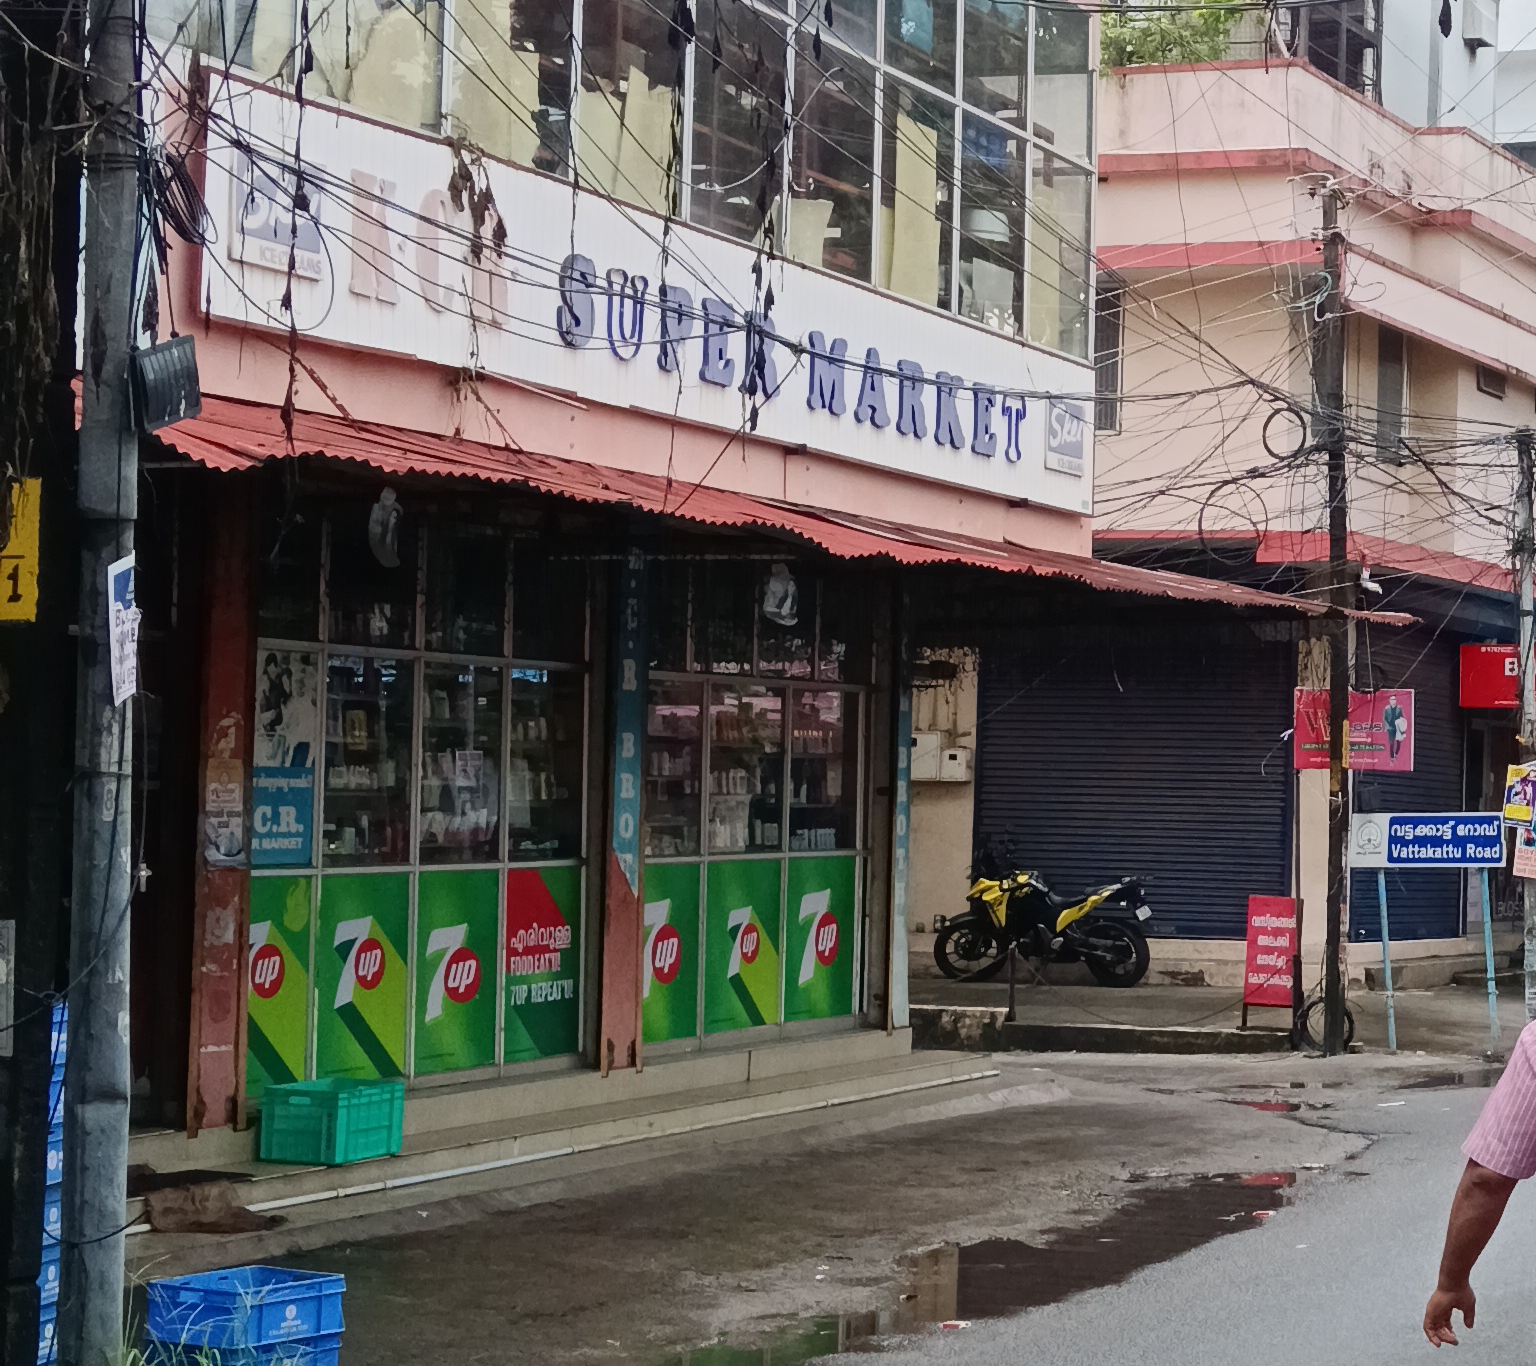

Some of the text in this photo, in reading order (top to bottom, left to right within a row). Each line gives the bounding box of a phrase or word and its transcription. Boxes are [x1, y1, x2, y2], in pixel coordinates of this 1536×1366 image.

[557, 253, 1027, 464] SUPER MARKET
[1391, 843, 1500, 859] Vattakattu Road
[510, 954, 534, 976] FOOD
